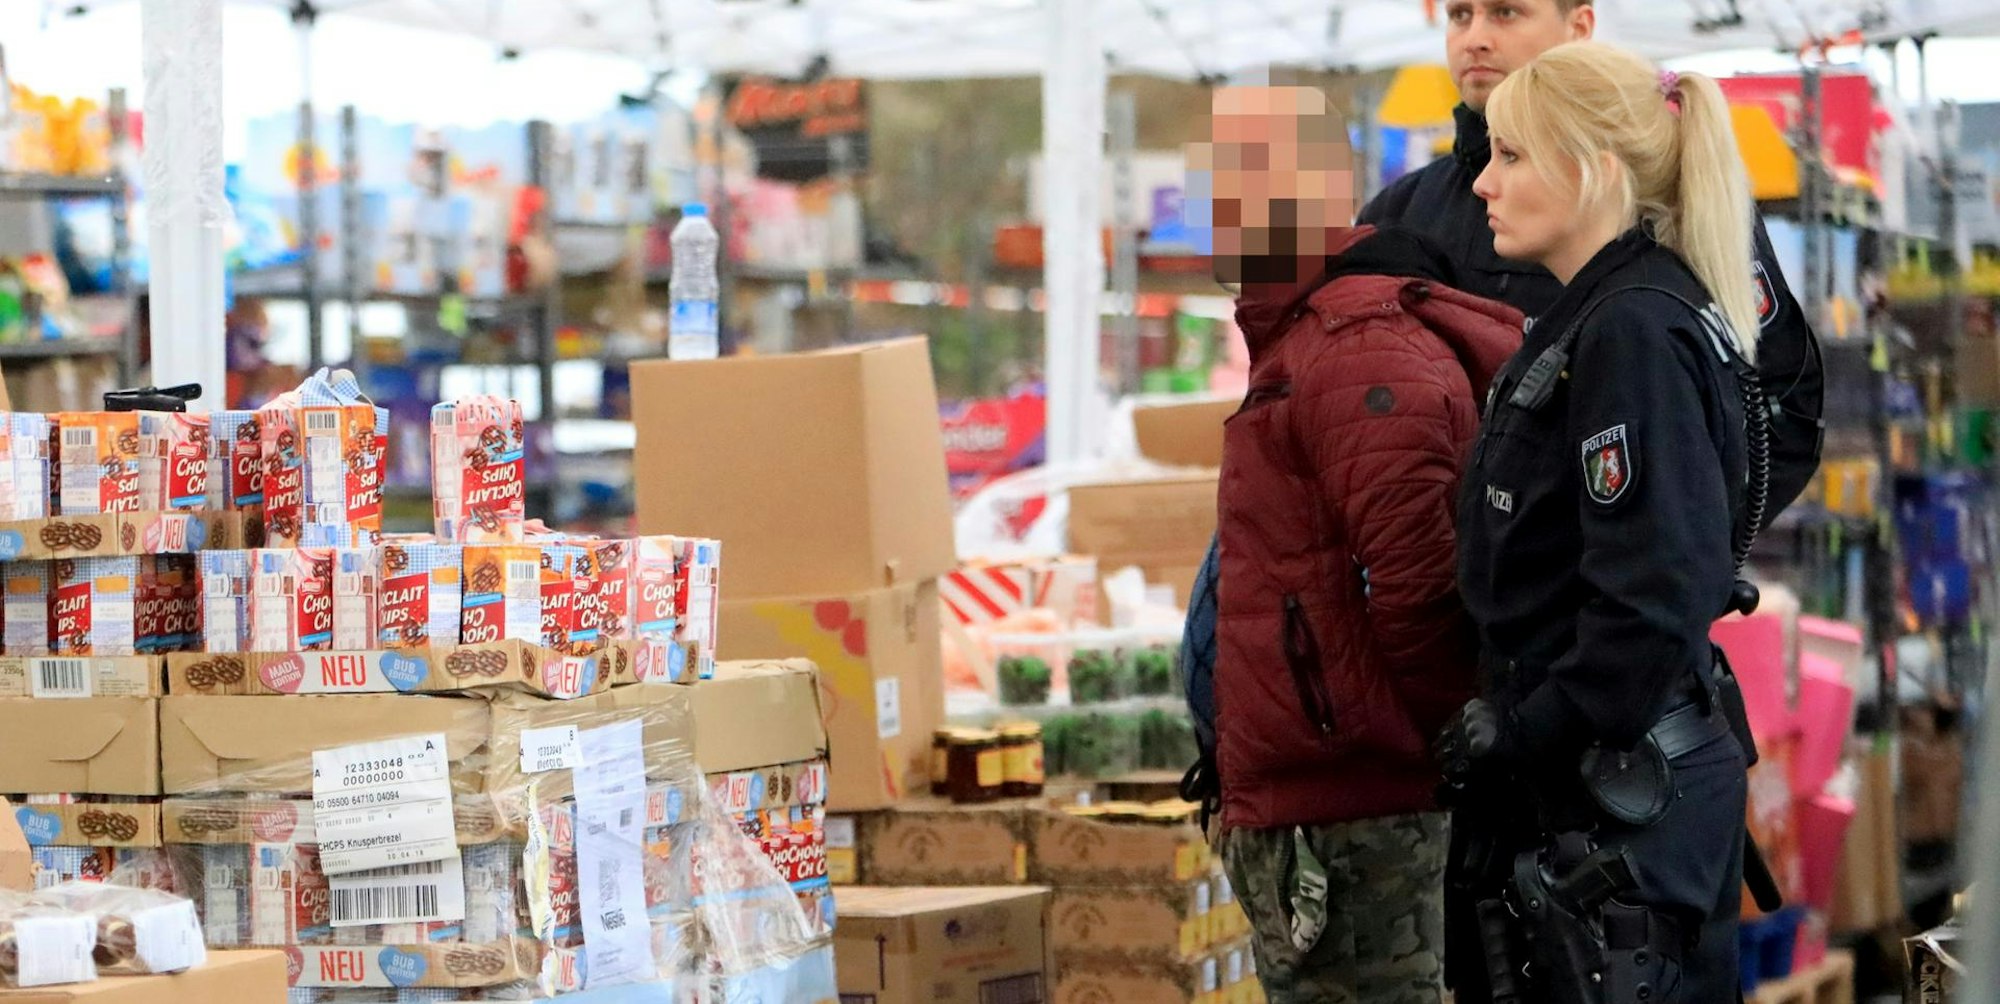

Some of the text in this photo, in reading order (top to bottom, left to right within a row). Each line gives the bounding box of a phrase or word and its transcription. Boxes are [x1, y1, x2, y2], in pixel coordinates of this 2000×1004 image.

[1583, 427, 1624, 452] POLIZEI
[481, 463, 516, 484] CHIPS
[466, 480, 522, 505] CHOCLAIT
[268, 659, 299, 680] MADL
[321, 655, 367, 687] NEU
[393, 658, 416, 675] BUB
[272, 670, 302, 689] EDITION
[425, 740, 434, 751] A
[314, 768, 321, 778] A
[345, 757, 404, 774] 12333048
[343, 770, 404, 787] 00000000
[327, 796, 349, 809] 05500
[352, 791, 375, 805] 64710
[377, 789, 400, 802] 04094
[28, 814, 50, 831] BUB
[347, 832, 402, 849] Knusperbrezel
[319, 950, 365, 982] NEU
[392, 954, 415, 970] BUB
